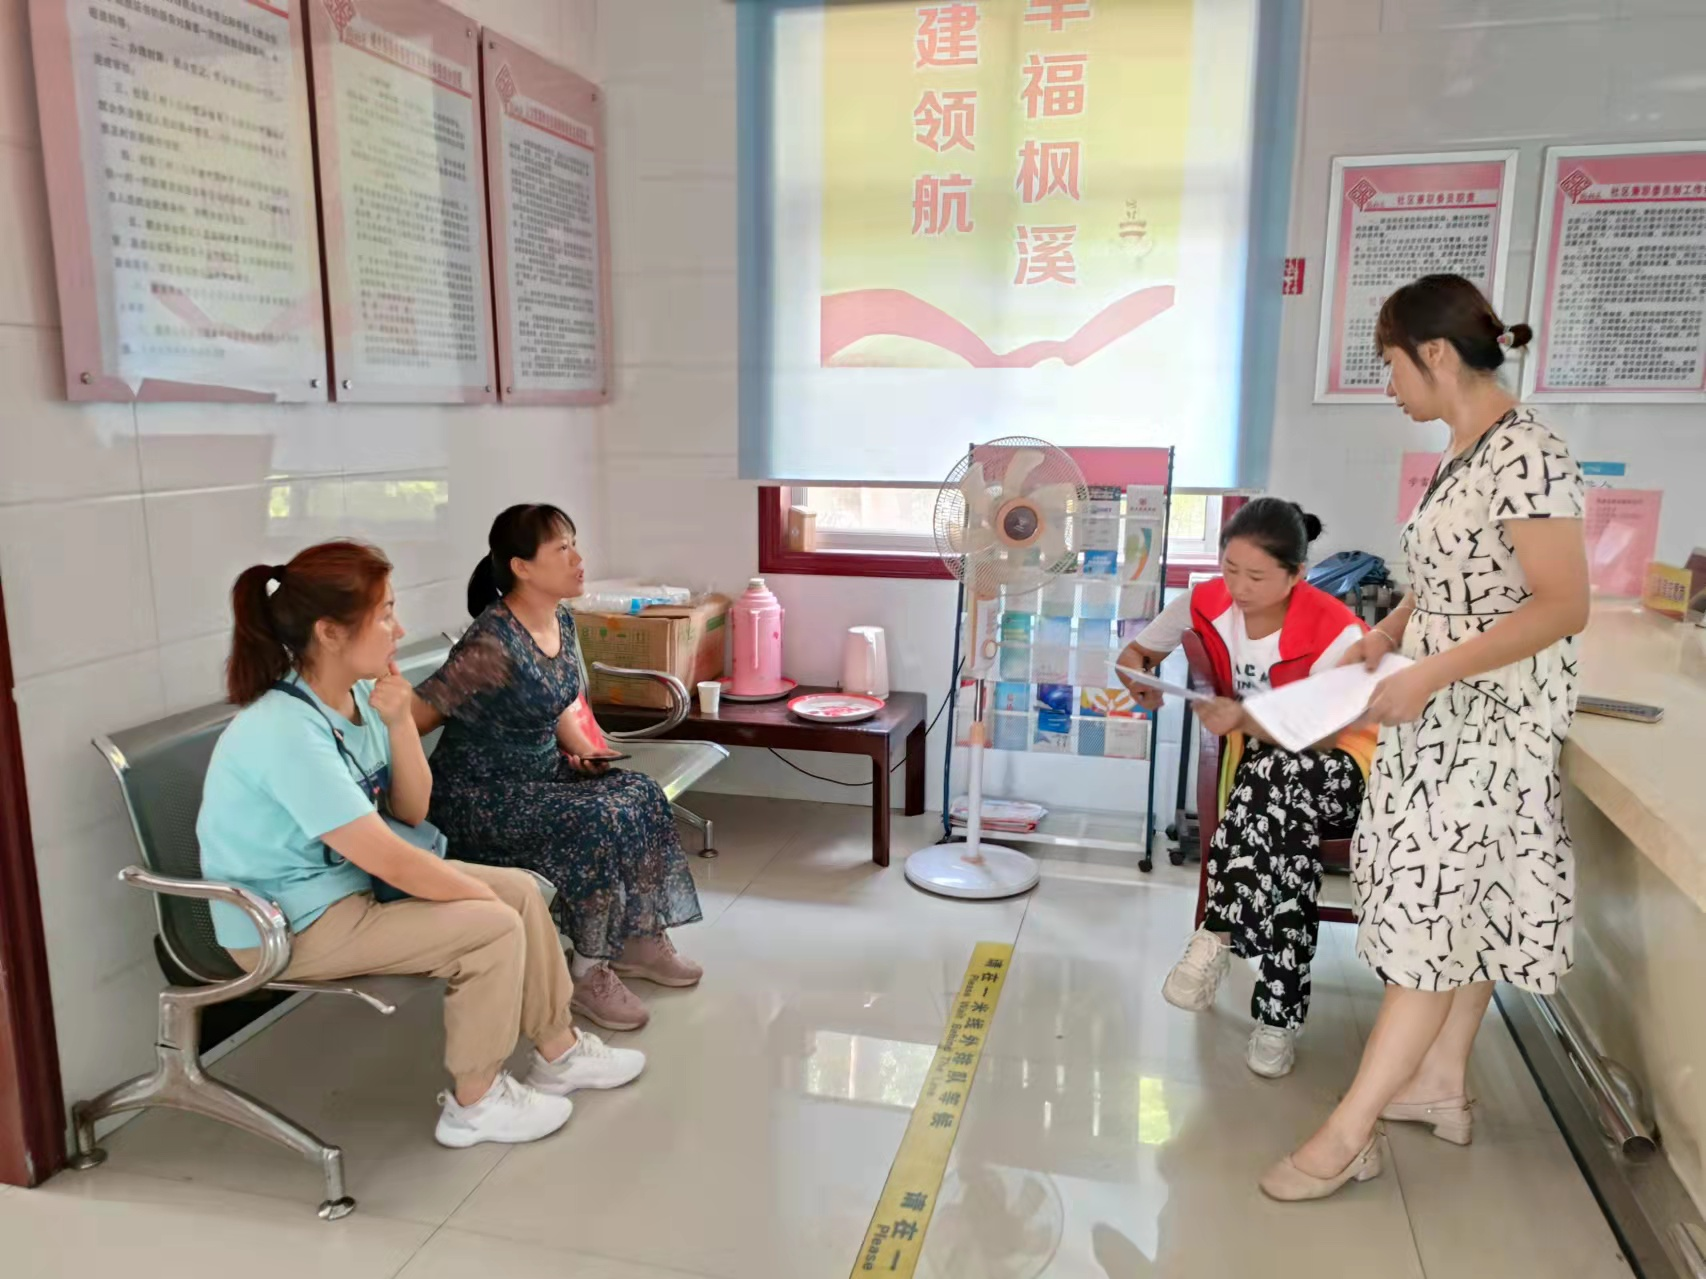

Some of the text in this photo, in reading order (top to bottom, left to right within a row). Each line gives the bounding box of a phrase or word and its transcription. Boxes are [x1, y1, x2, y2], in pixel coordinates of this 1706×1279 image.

[911, 3, 981, 237] 建领航
[930, 958, 1003, 1128] 请在一米线外排队等候
[862, 1223, 891, 1271] Please
[890, 1191, 928, 1271] 请在一
